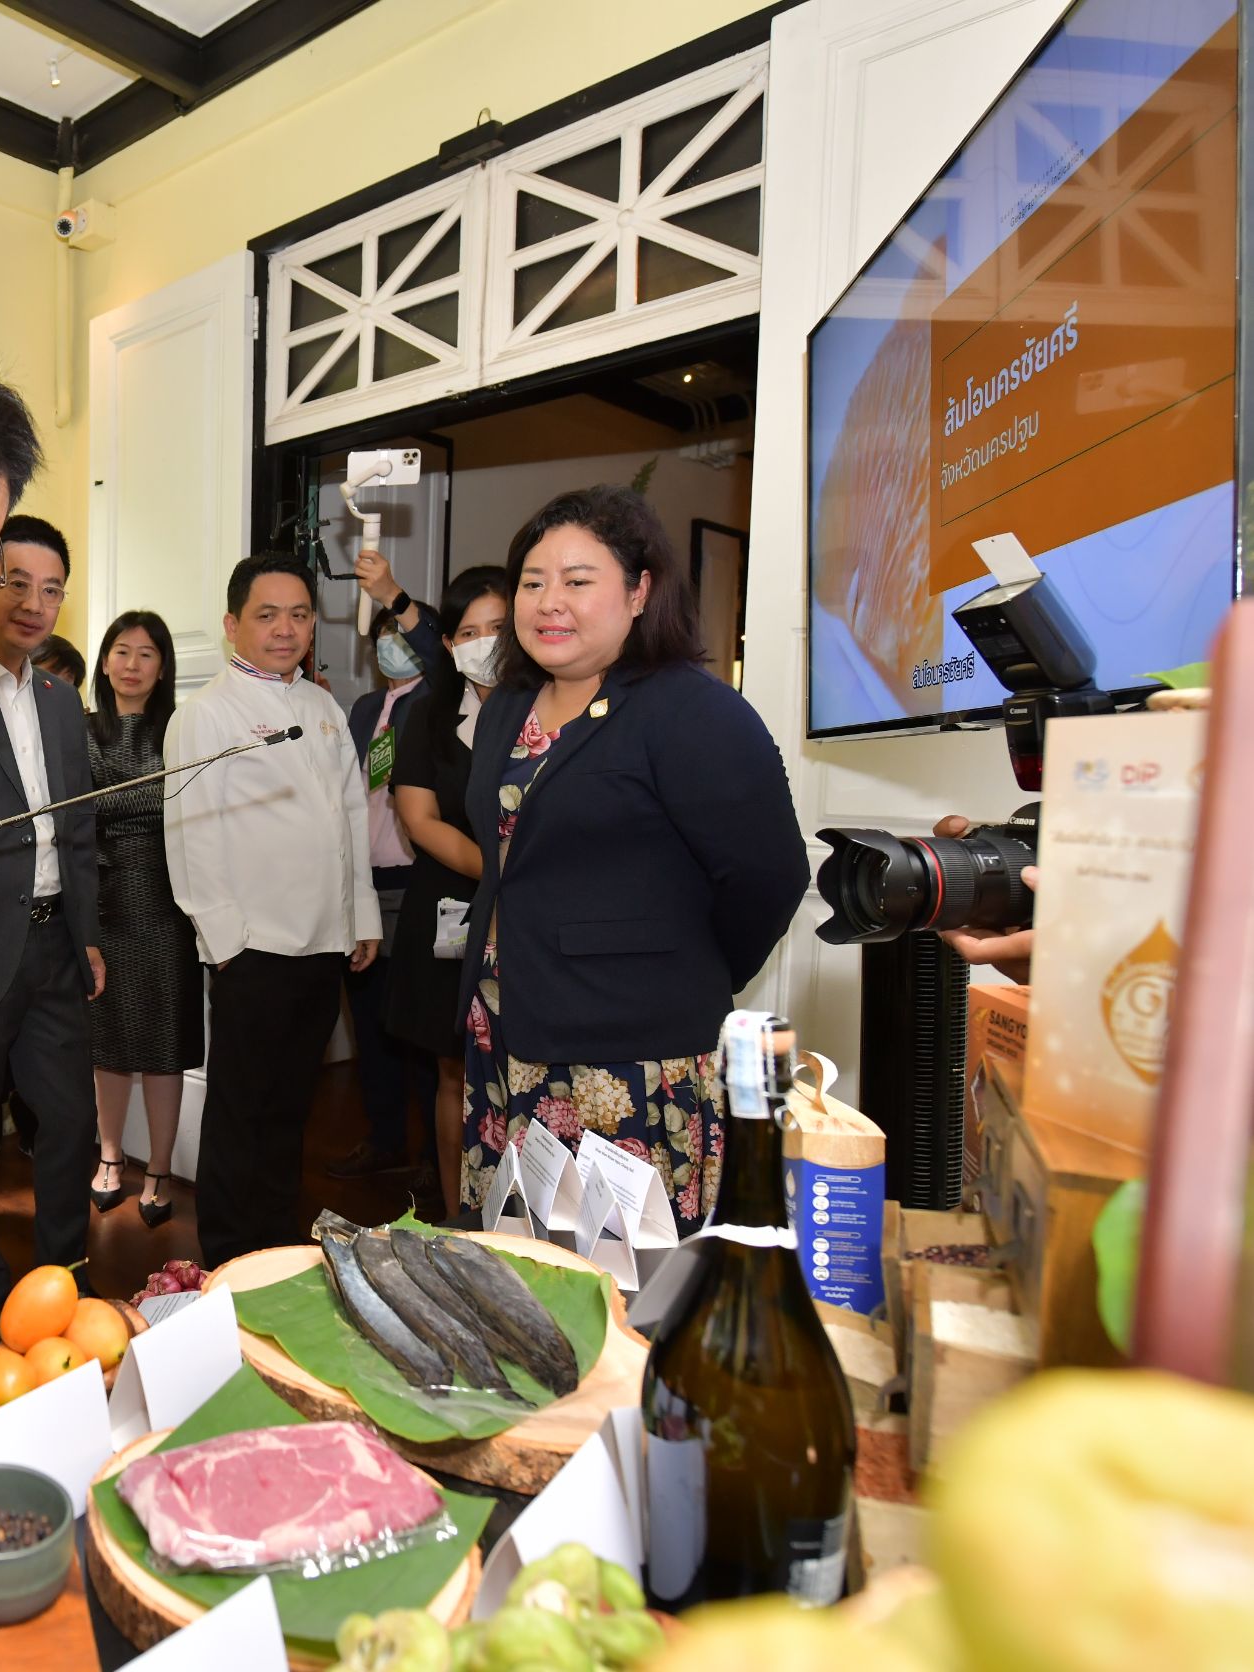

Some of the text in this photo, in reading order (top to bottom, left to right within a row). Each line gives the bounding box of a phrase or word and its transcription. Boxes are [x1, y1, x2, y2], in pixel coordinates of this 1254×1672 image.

[944, 300, 1079, 437] ส้มโอนครชัยศรี
[940, 410, 1039, 490] จังหวัดนครปฐม
[912, 651, 975, 689] ส้มโอนครชัยศรี
[1009, 816, 1036, 826] Canon
